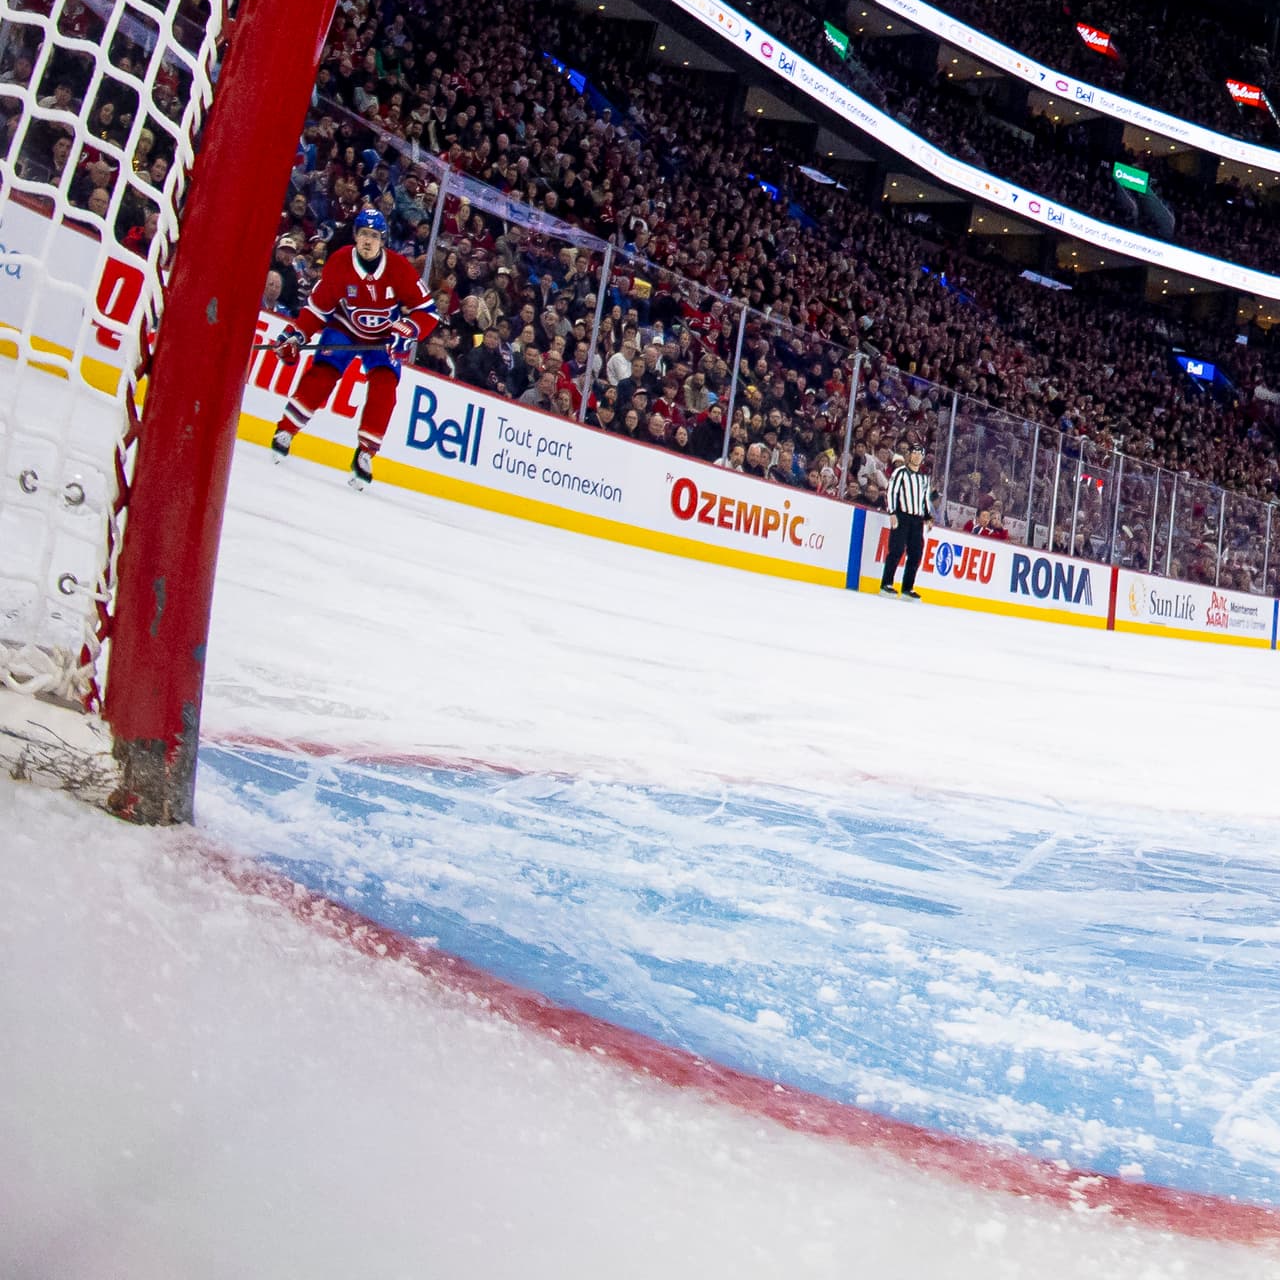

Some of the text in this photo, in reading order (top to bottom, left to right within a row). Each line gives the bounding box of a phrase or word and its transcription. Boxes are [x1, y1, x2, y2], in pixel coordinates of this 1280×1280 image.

[778, 52, 797, 77] Bell
[1076, 87, 1095, 104] Bell
[1047, 207, 1065, 226] Bell
[406, 385, 486, 466] Bell
[497, 416, 572, 462] Tout part
[492, 450, 623, 503] d'une connexion
[1010, 553, 1093, 607] RONA
[1149, 590, 1195, 621] Sun Life
